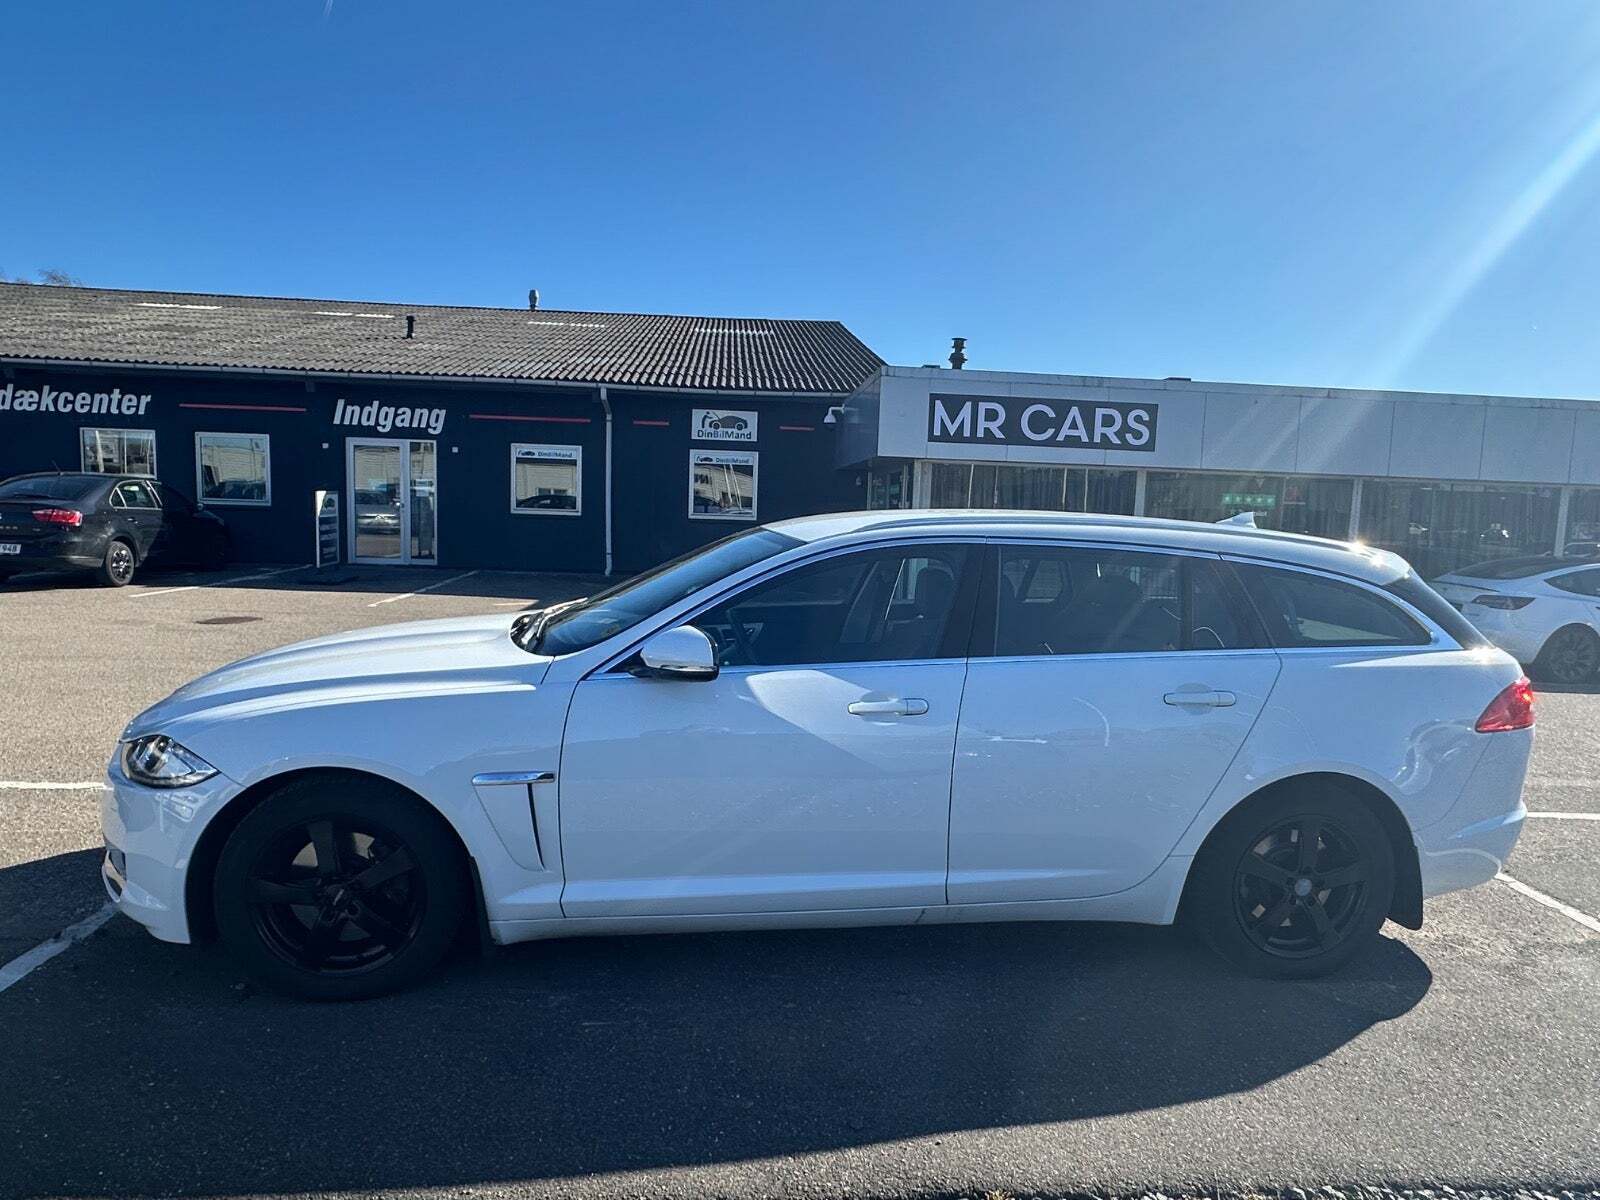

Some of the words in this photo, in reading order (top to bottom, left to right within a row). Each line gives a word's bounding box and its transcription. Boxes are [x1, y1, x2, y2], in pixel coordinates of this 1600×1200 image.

[0, 384, 151, 415] dækcenter
[333, 398, 446, 434] Indgang
[697, 429, 752, 440] DinBilMand
[933, 399, 1006, 439] MR
[1020, 403, 1151, 446] CARS
